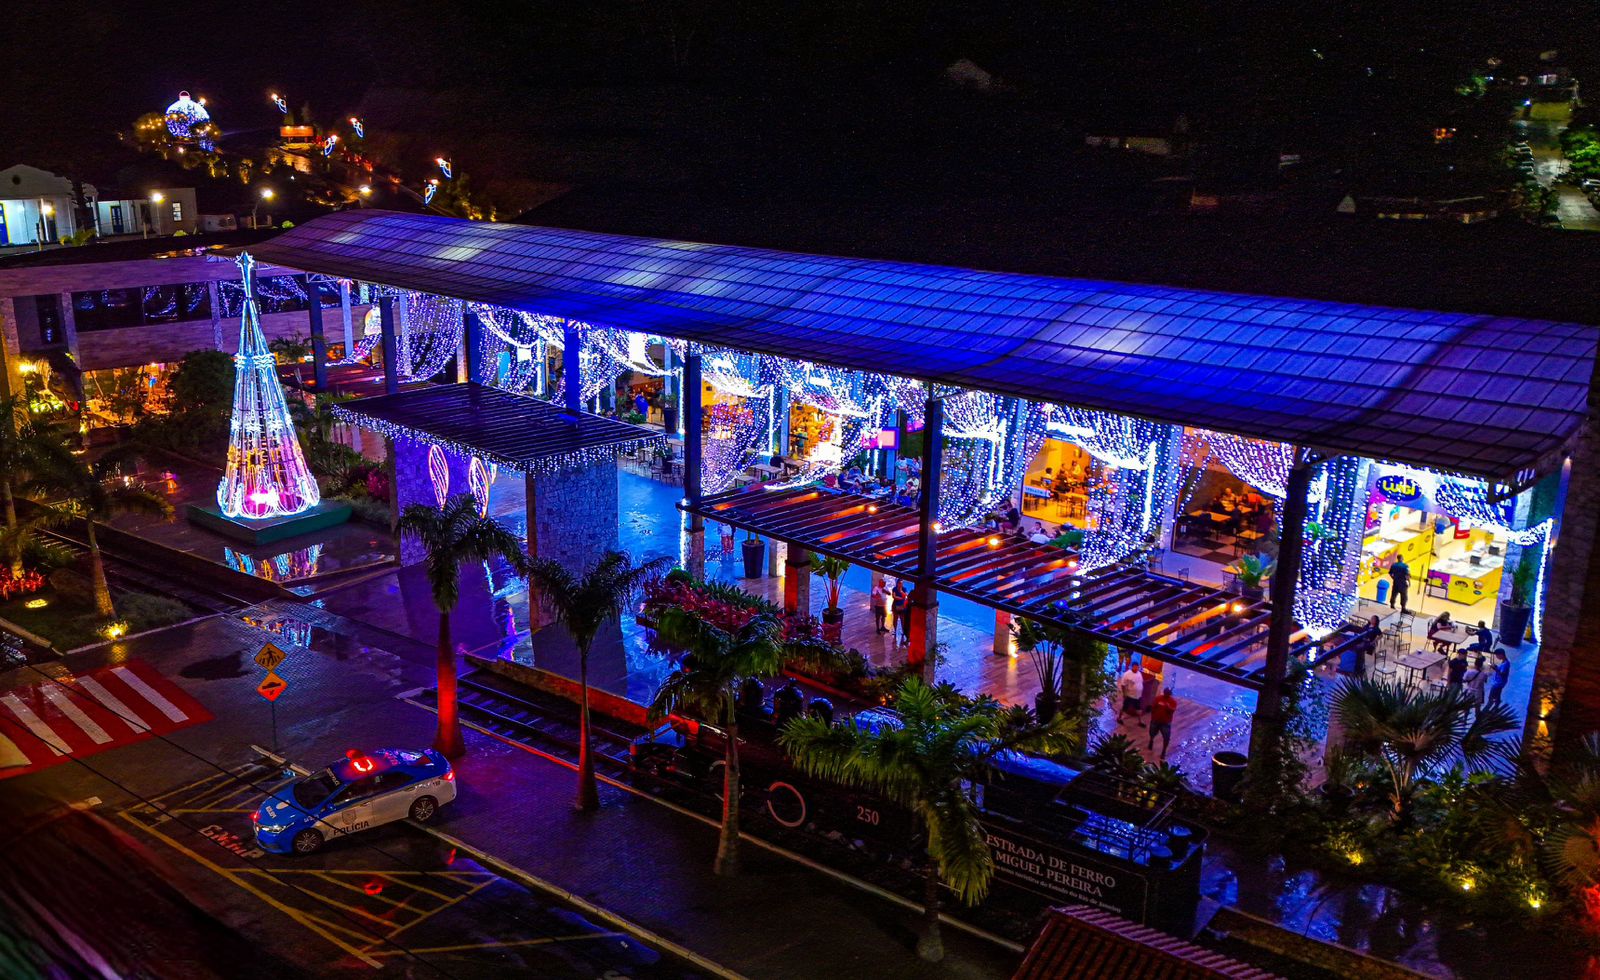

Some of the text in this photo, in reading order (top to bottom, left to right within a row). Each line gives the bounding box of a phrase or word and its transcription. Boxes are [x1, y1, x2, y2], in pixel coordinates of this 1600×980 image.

[857, 806, 879, 826] 250
[986, 834, 1116, 888] ESTRADA DE FERRO
[996, 850, 1043, 877] MIGUEL
[1046, 869, 1103, 898] PEREIRA
